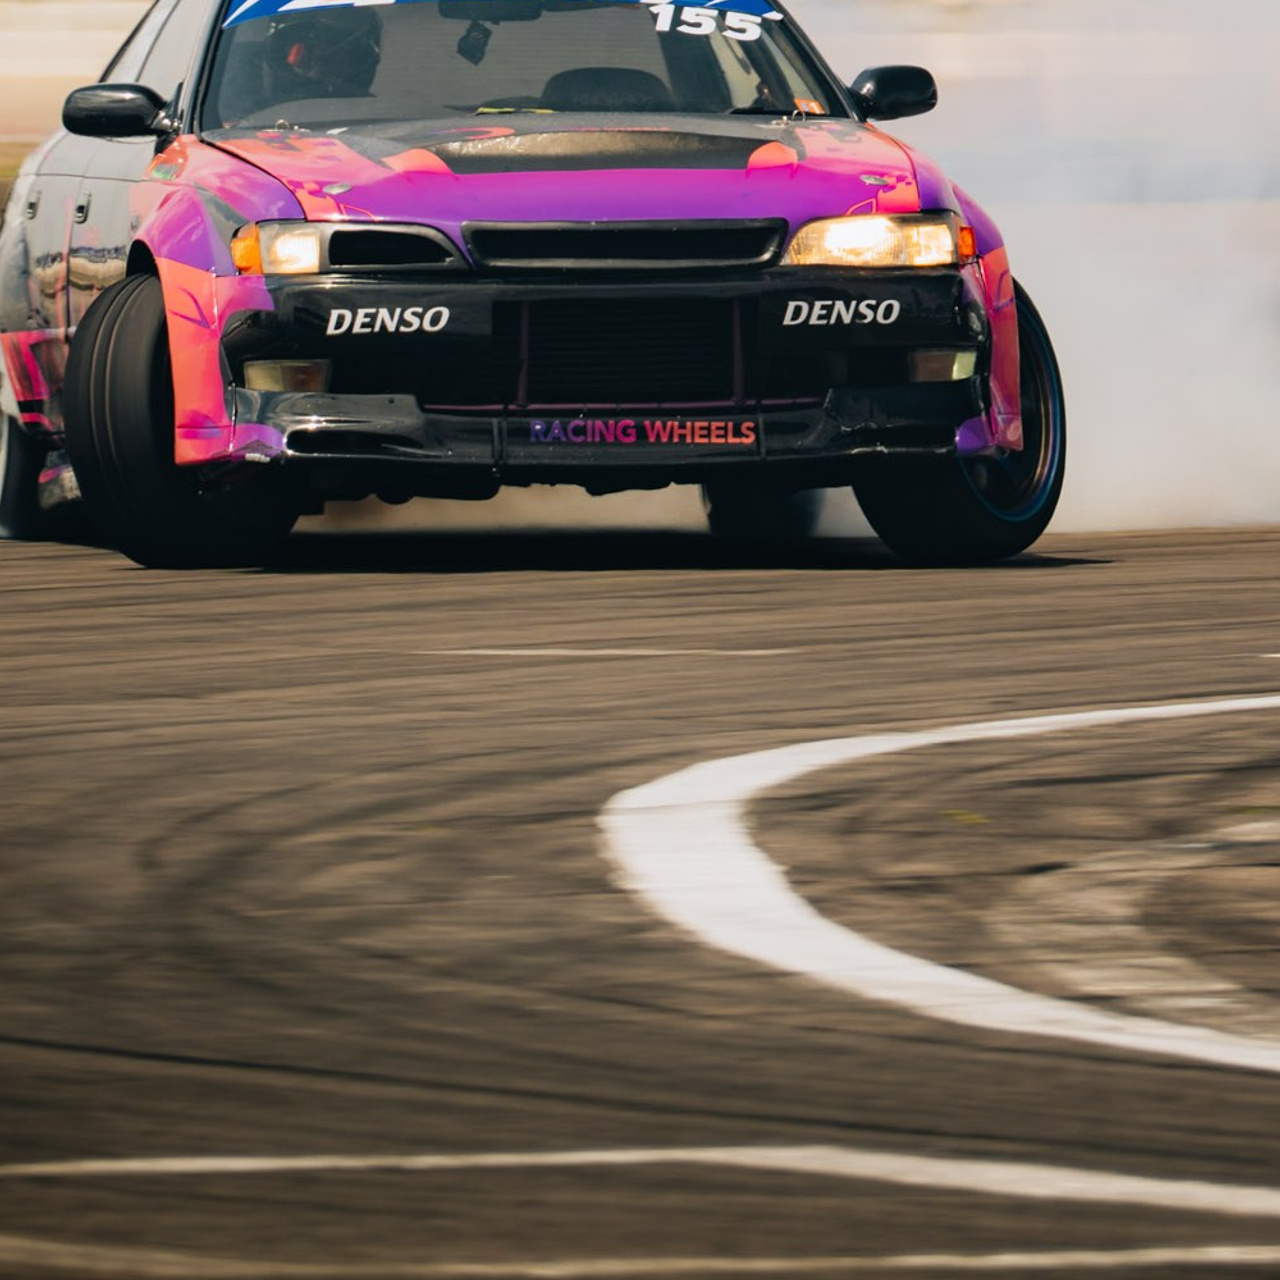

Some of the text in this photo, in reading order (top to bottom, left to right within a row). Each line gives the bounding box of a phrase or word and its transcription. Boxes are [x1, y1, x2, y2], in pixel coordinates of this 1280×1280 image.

[648, 3, 762, 41] 155
[325, 306, 451, 336] DENSO
[782, 299, 901, 326] DENSO
[529, 420, 756, 444] RACING WHEELS
